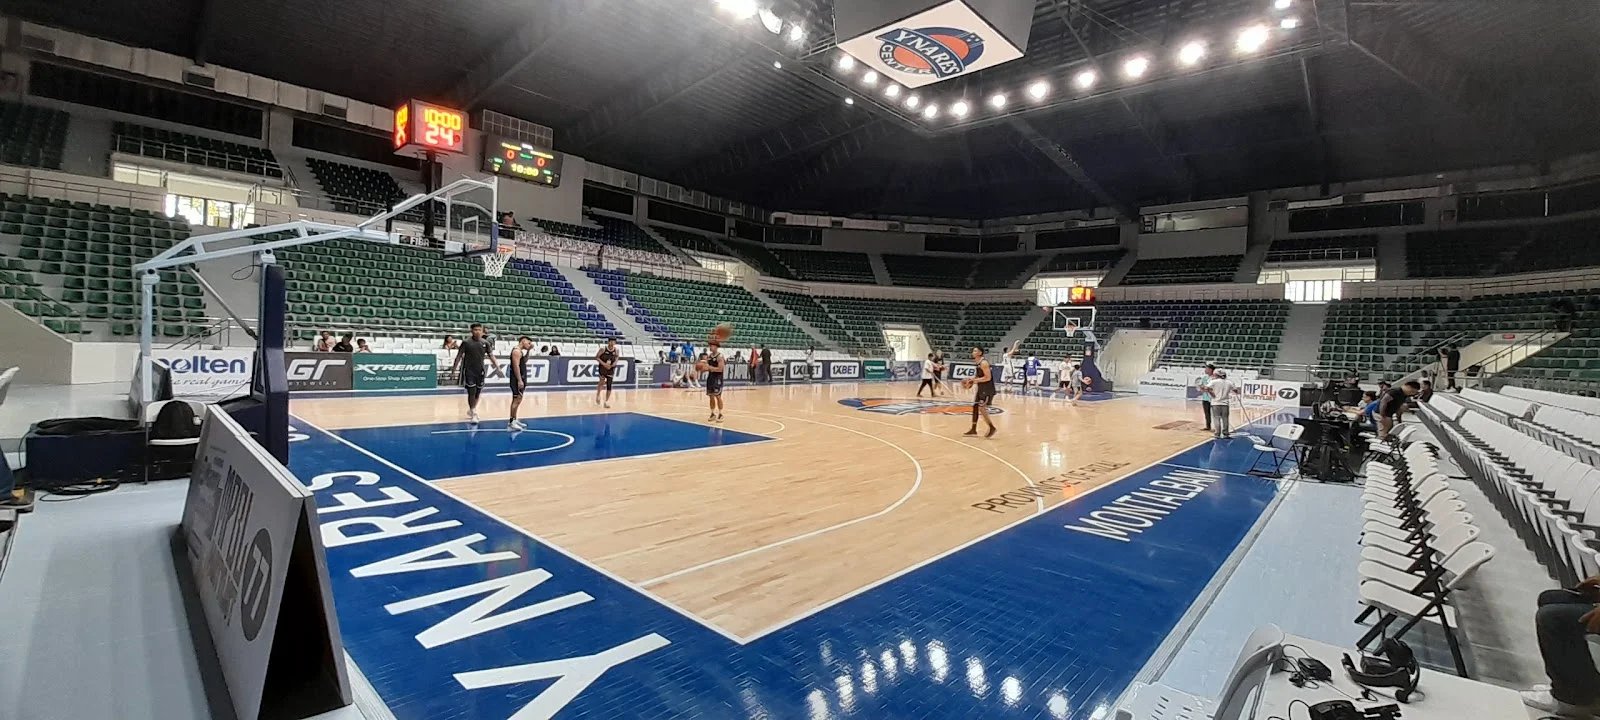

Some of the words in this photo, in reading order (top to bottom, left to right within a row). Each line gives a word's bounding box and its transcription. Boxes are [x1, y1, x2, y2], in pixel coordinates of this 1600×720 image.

[881, 44, 933, 75] CENTER
[893, 29, 961, 75] YNARES
[424, 108, 461, 131] 10:00
[425, 123, 454, 147] 24
[410, 236, 430, 247] FIBA
[355, 363, 431, 375] XTREME
[485, 363, 546, 379] 1XET
[572, 364, 625, 378] 1XBT
[833, 364, 858, 376] 1XBET
[956, 367, 976, 377] 1XB
[1281, 389, 1296, 398] 77
[1063, 469, 1222, 542] MONTALBAN
[243, 543, 270, 621] 77
[306, 470, 672, 720] YNARES
